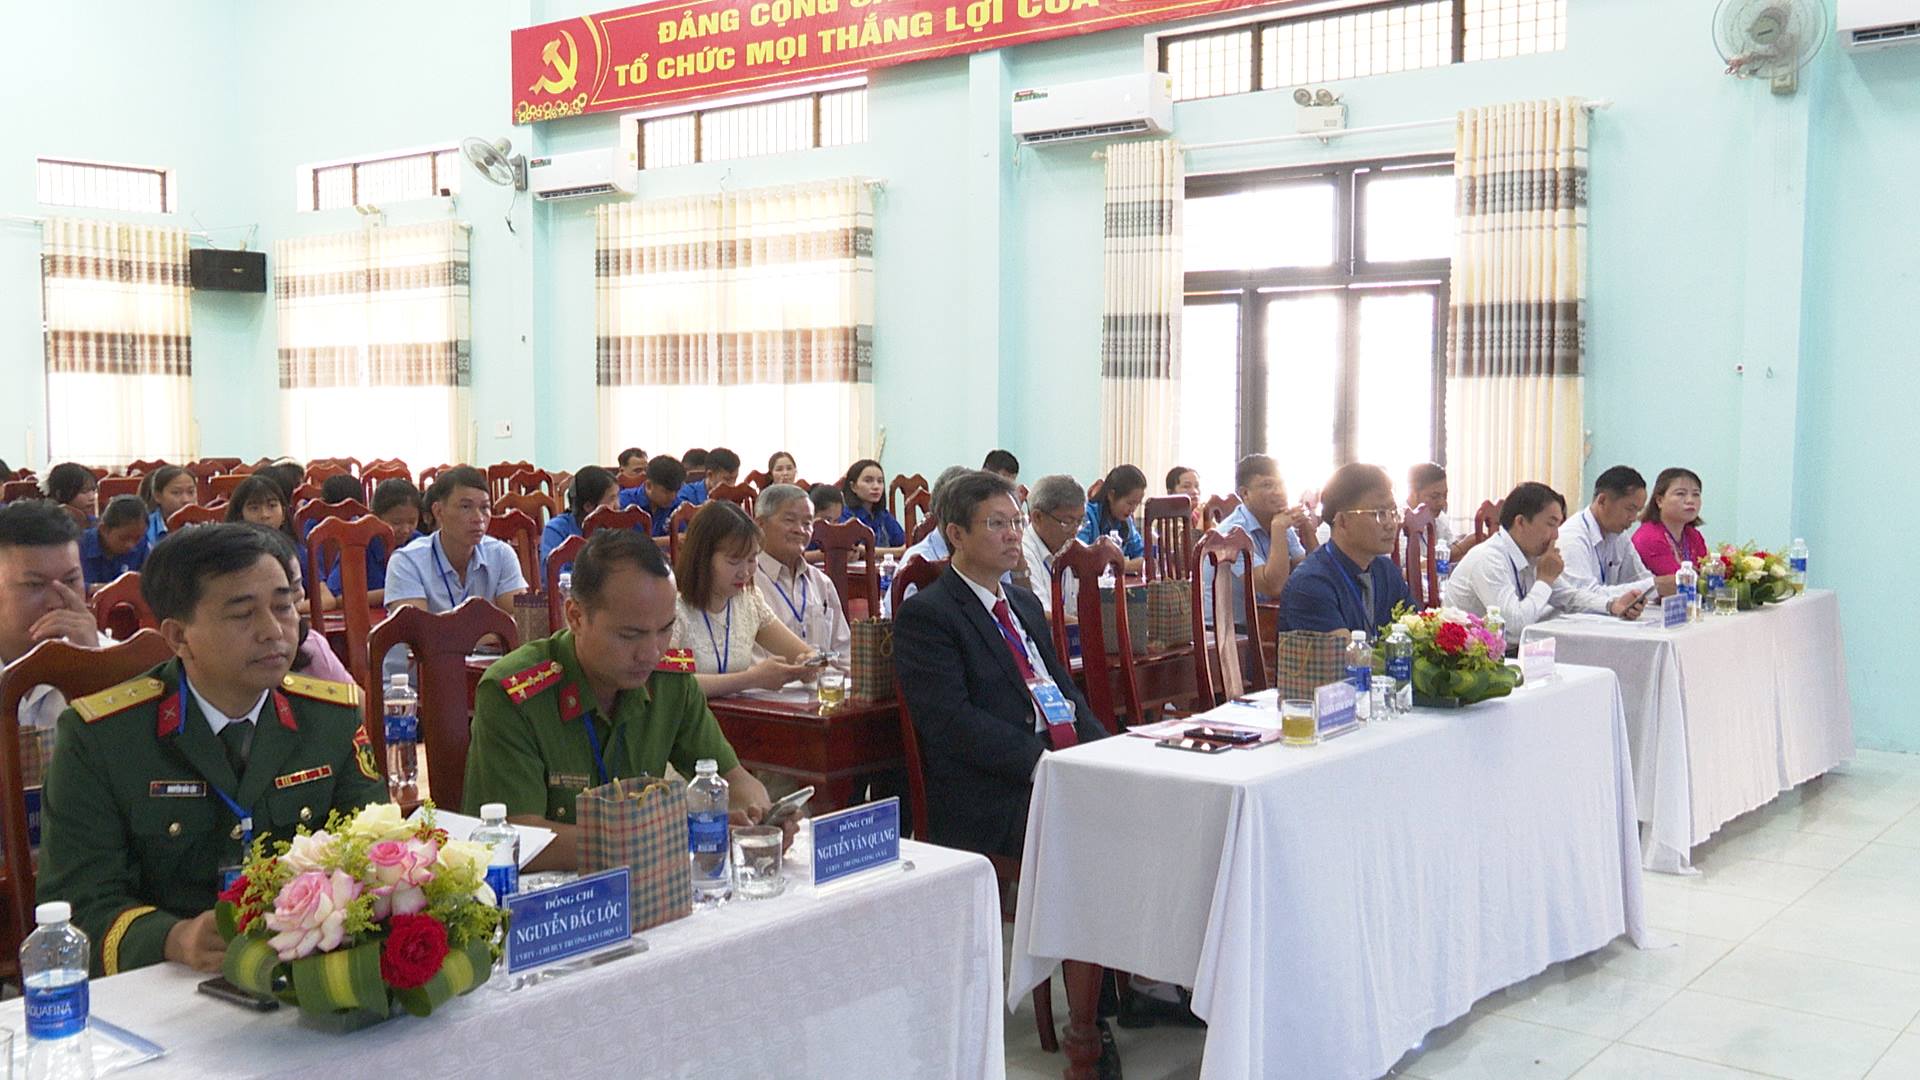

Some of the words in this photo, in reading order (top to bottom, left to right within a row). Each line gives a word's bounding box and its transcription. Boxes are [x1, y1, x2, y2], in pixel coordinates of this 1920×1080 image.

[615, 53, 649, 86] TỔ
[657, 46, 735, 80] CHỨC
[747, 34, 807, 65] MỌI
[818, 12, 932, 53] THẮNG
[946, 0, 1003, 32] LỢI
[658, 9, 740, 44] ĐẢNG
[868, 828, 895, 849] QUANG
[545, 894, 574, 910] ĐỒNG
[576, 887, 594, 902] CHÍ
[516, 912, 568, 944] NGUYỄN
[570, 905, 595, 930] ĐẮC
[597, 900, 622, 923] LỘC
